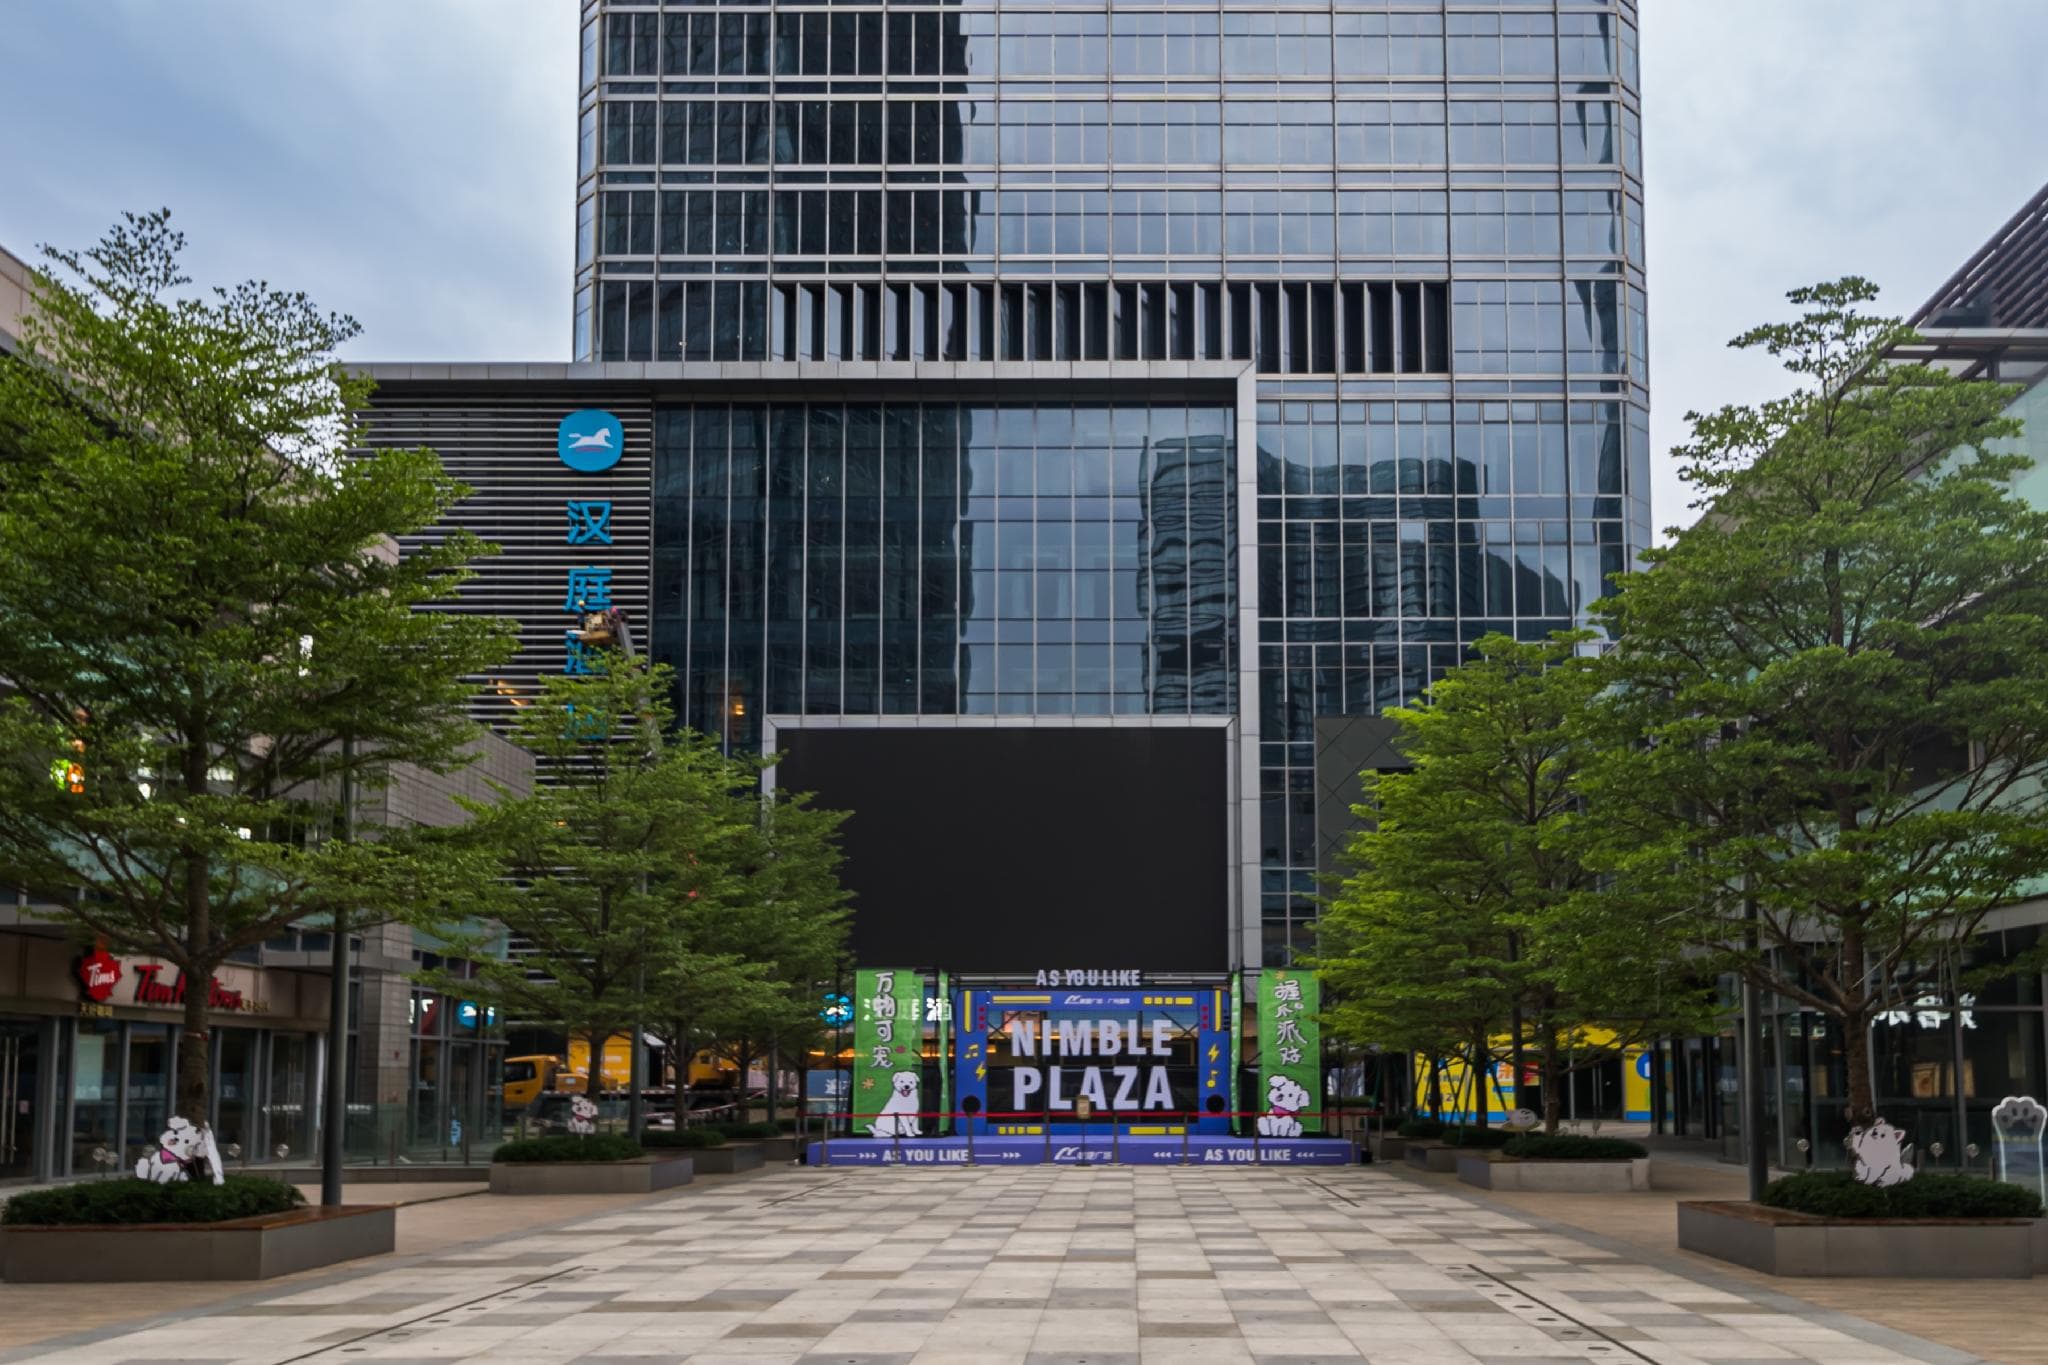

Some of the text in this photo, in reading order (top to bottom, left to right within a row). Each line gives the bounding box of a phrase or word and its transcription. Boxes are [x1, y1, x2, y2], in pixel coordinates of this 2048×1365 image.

[563, 500, 613, 740] 汉庭
[1036, 969, 1140, 986] AS YOU LIKE
[1011, 1019, 1173, 1056] NIMBLE
[1013, 1065, 1175, 1110] PLAZA
[906, 1149, 934, 1162] YOU
[938, 1149, 969, 1162] LIKE
[1204, 1149, 1291, 1162] AS YOU LIKE
